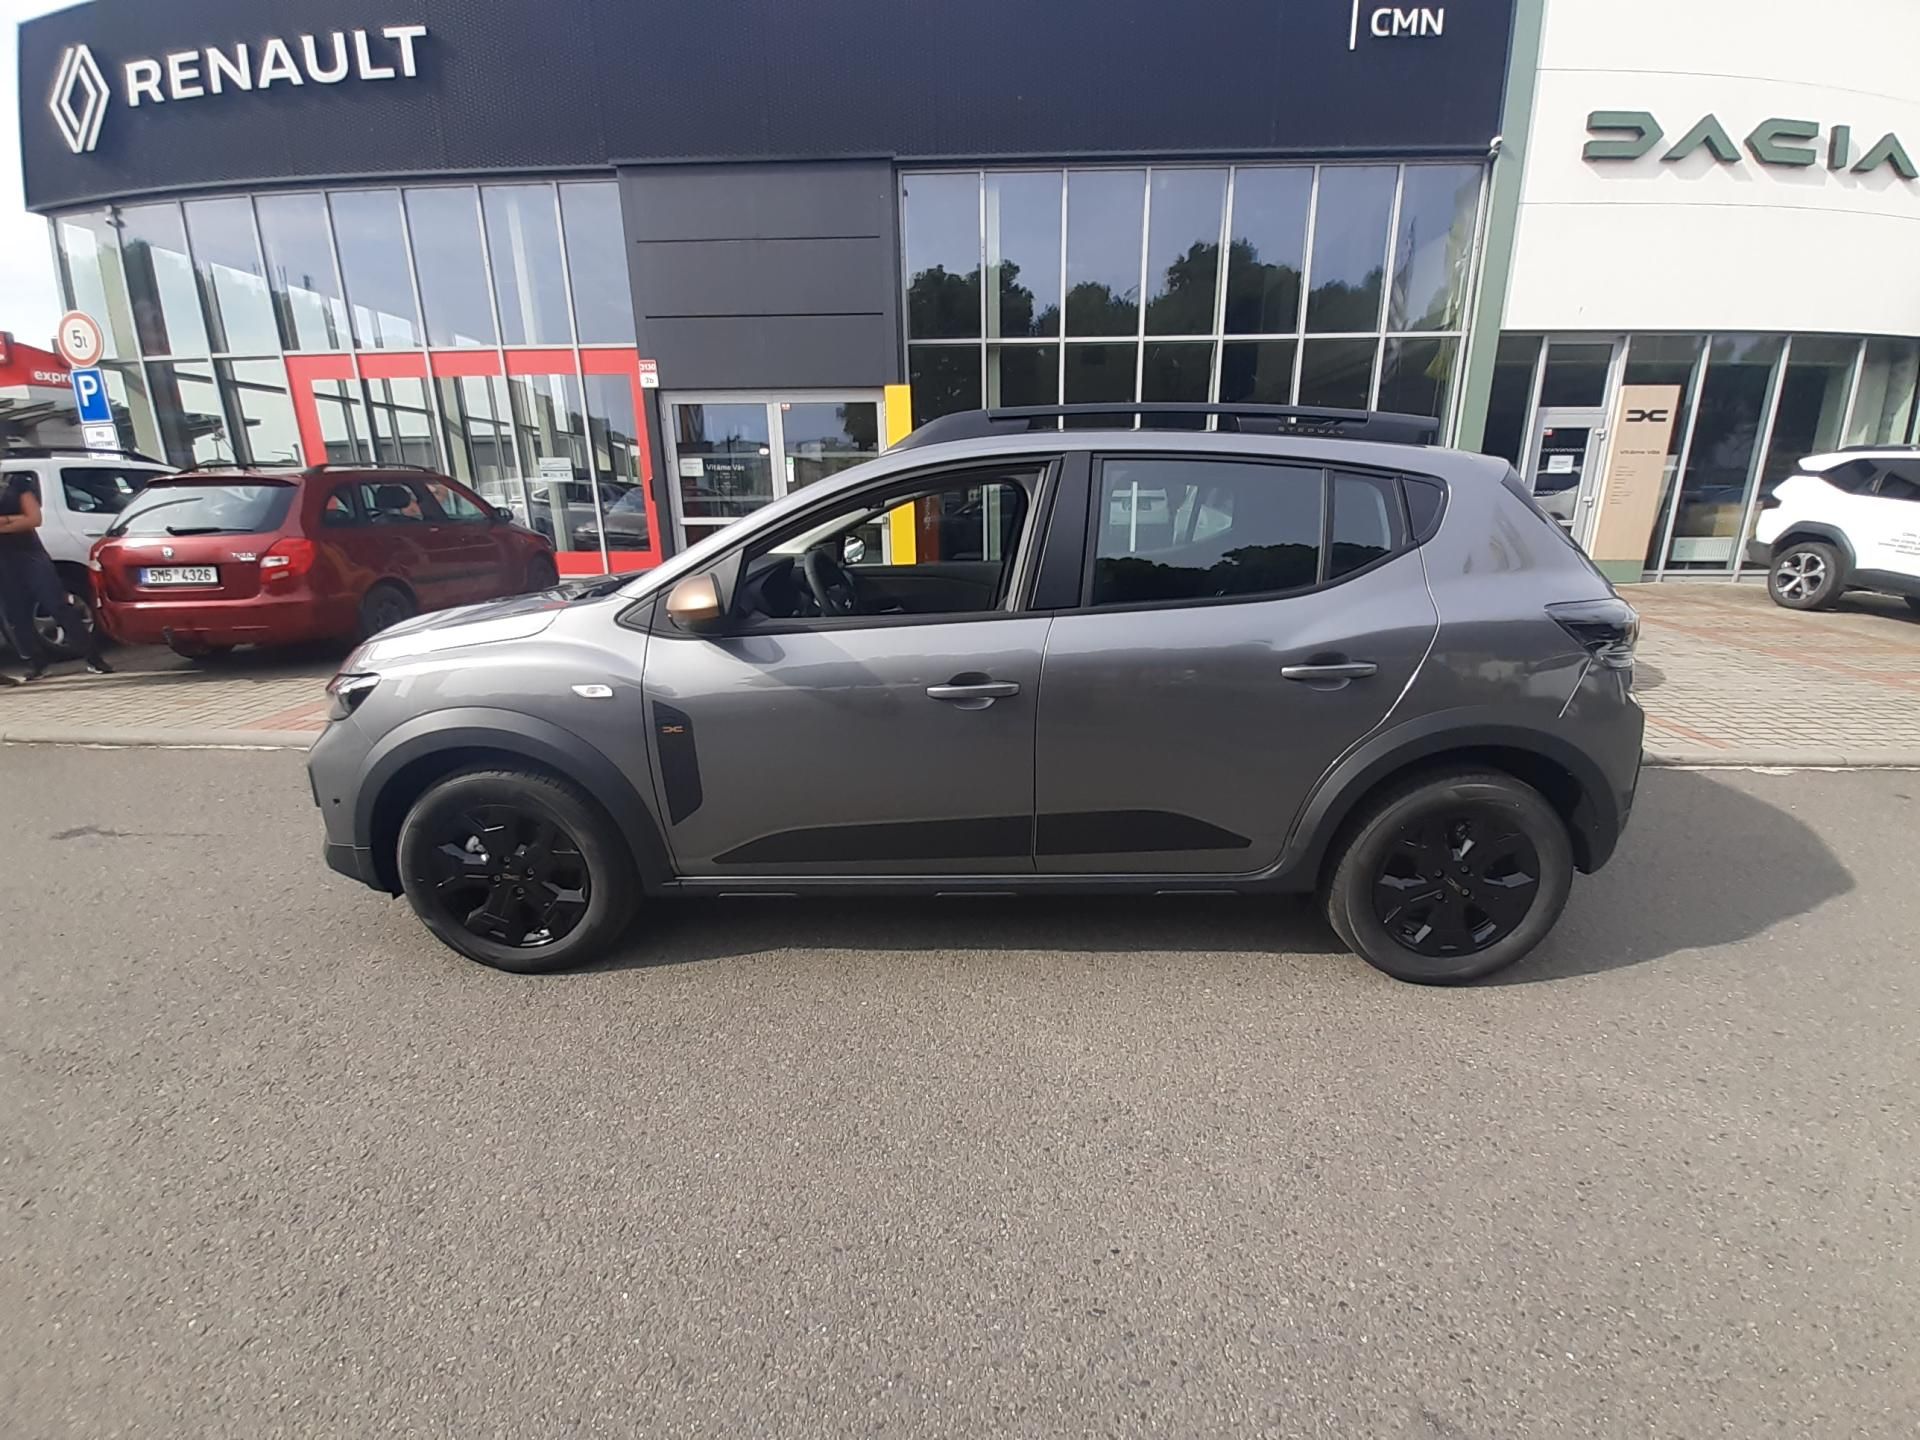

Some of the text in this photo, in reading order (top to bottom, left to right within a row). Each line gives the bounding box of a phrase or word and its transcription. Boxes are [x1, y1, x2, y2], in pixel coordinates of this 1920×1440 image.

[1371, 7, 1444, 37] CMN
[124, 25, 427, 107] RENAULT
[1582, 110, 1919, 180] DACIA
[77, 375, 98, 407] P
[149, 568, 212, 582] 5M5 4326
